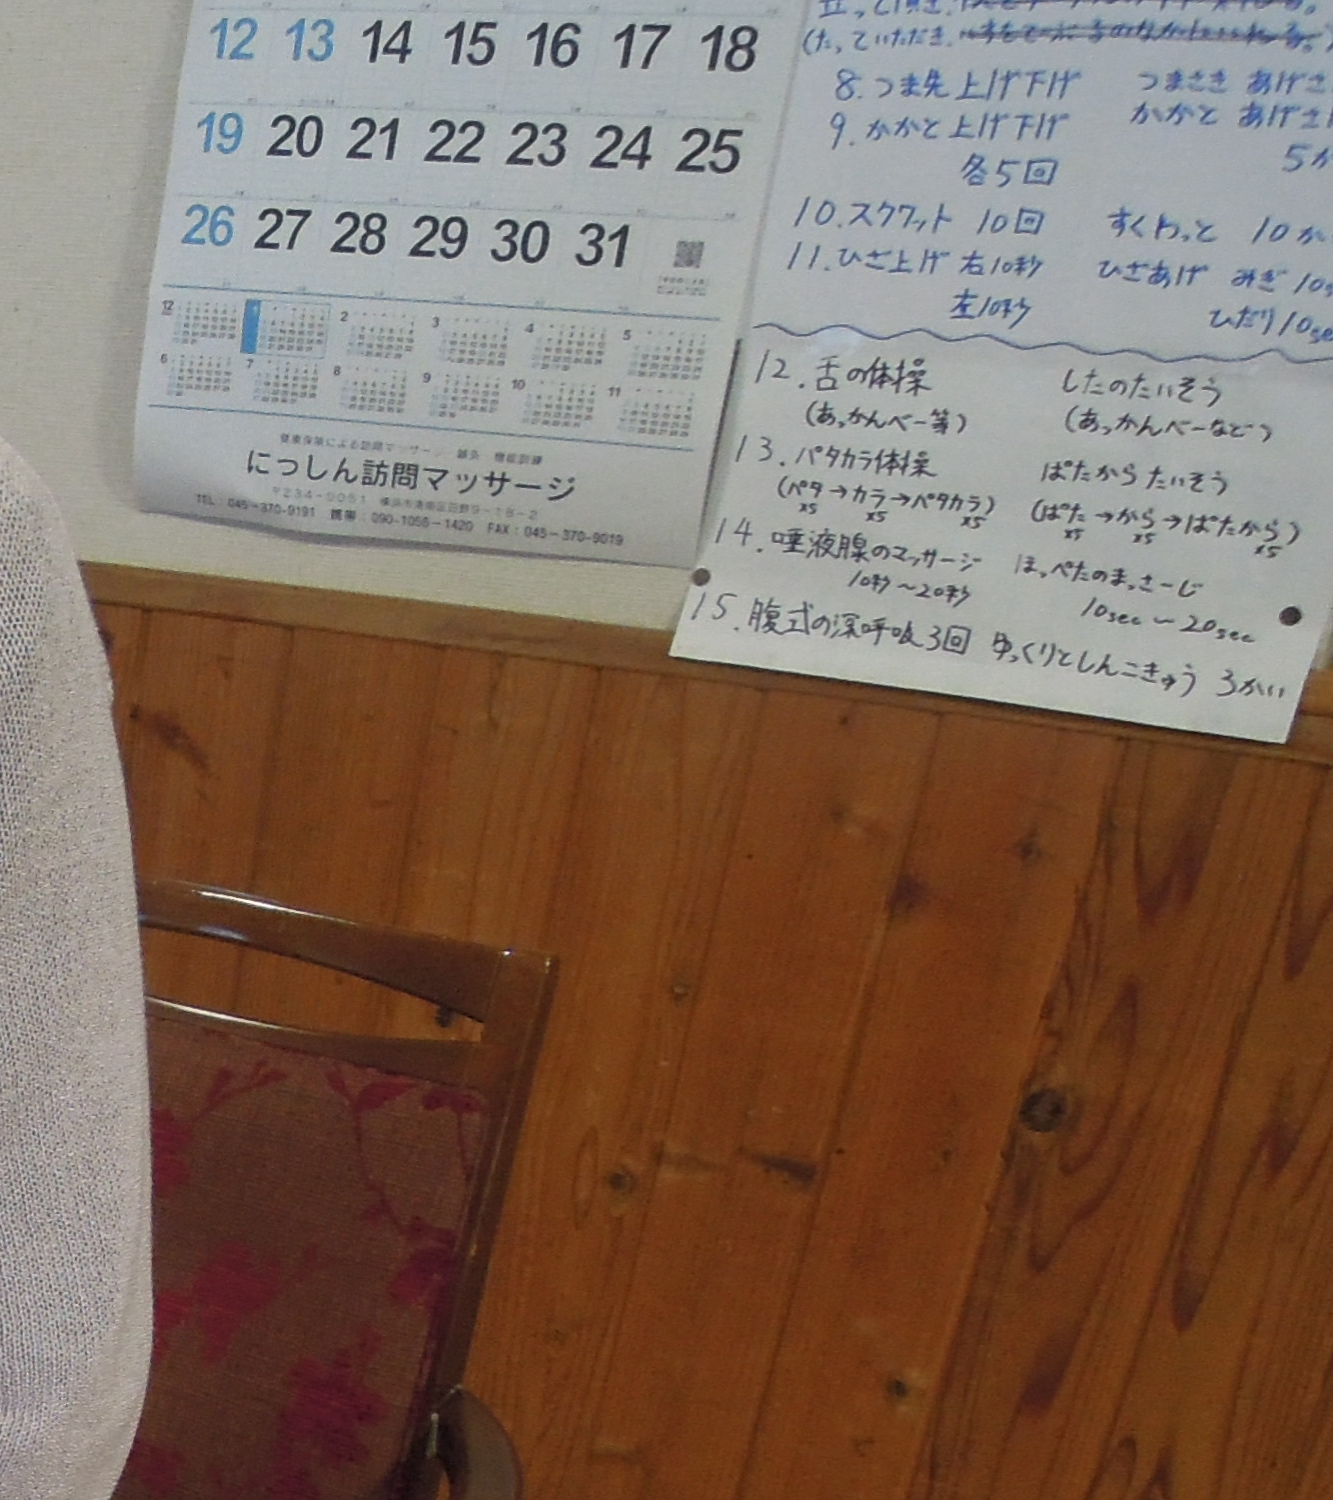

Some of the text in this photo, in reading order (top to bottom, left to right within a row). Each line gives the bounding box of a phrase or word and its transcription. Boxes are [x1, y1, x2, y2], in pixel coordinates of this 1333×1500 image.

[209, 18, 759, 72] 12 13 14 15 16 17 18
[197, 112, 743, 174] 19 20 21 22 23 24 25
[962, 152, 1059, 187] 各5回
[182, 204, 630, 267] 26 27 28 29 30 31
[246, 449, 576, 501] にっしん訪問マッサージ
